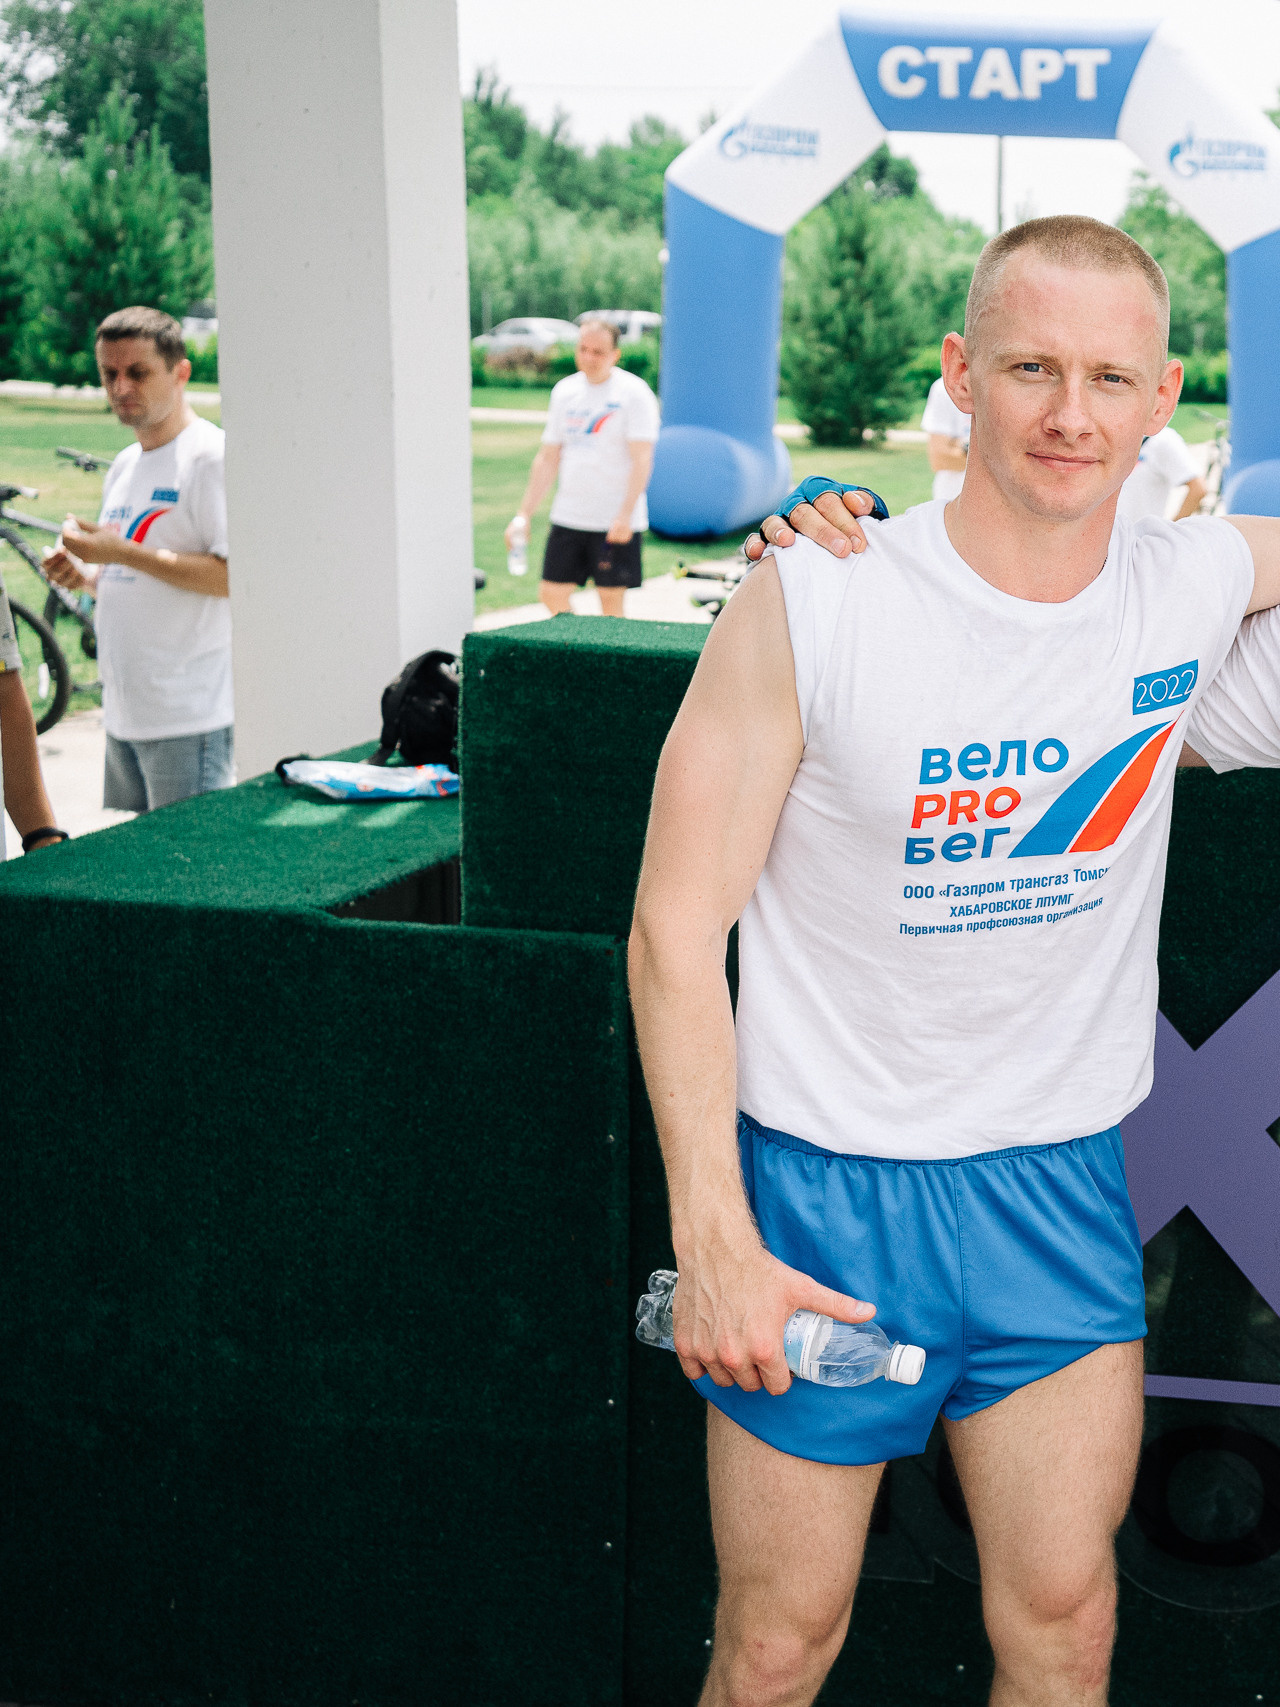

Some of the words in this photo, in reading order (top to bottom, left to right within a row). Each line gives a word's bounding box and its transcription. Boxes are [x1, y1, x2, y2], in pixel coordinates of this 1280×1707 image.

[876, 44, 1112, 101] СТАРТ
[1136, 669, 1196, 708] 2022
[911, 786, 1022, 829] PRO
[903, 885, 935, 899] ООО
[938, 880, 1006, 898] «Газпром
[1009, 873, 1070, 891] трансгаз
[949, 898, 1033, 918] ХАБАРОВСКОЕ
[1034, 893, 1075, 909] ЛПУМГ
[899, 923, 963, 937] Первичная
[966, 914, 1044, 933] профсоюзная
[1046, 897, 1104, 920] организация
